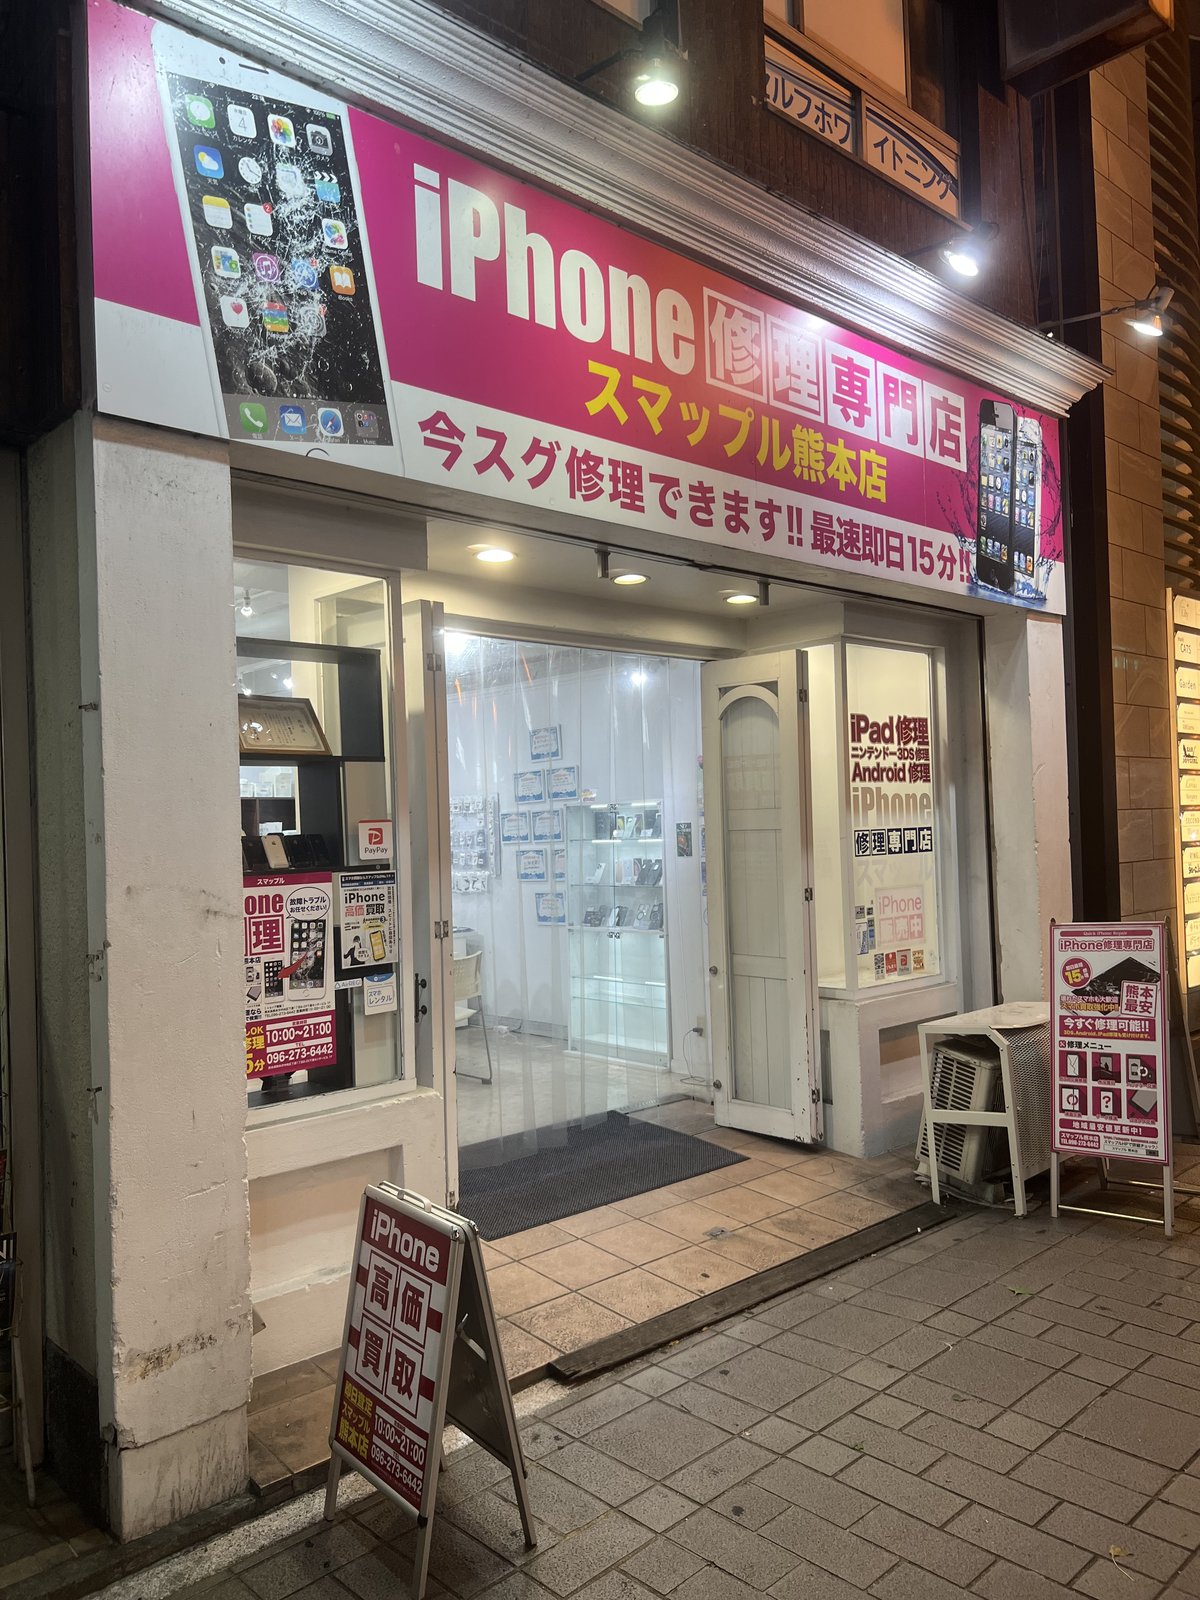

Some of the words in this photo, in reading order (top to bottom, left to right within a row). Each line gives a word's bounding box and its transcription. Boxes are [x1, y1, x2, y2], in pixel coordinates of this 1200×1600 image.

[413, 162, 695, 376] iPhone
[704, 288, 966, 470] 修理専門店
[585, 360, 887, 503] スマップル熊本店
[850, 713, 894, 744] iPad
[895, 714, 930, 746] 修理
[851, 761, 906, 783] Android
[908, 761, 931, 784] 修理
[852, 786, 932, 827] iPhone
[364, 846, 389, 855] PayPay
[854, 827, 932, 857] 修理専門店
[257, 877, 286, 886] スマップル
[344, 892, 386, 904] iPhone
[878, 895, 923, 914] iPhone
[1125, 999, 1153, 1015] 最安
[1126, 985, 1154, 1000] 熊本
[267, 1043, 333, 1065] 096-273-6442
[370, 1208, 440, 1273] iPhone
[367, 1258, 428, 1341] 高価
[359, 1321, 420, 1408] 買取
[339, 1416, 369, 1460] 熊本店
[371, 1443, 423, 1497] 096-273-6442
